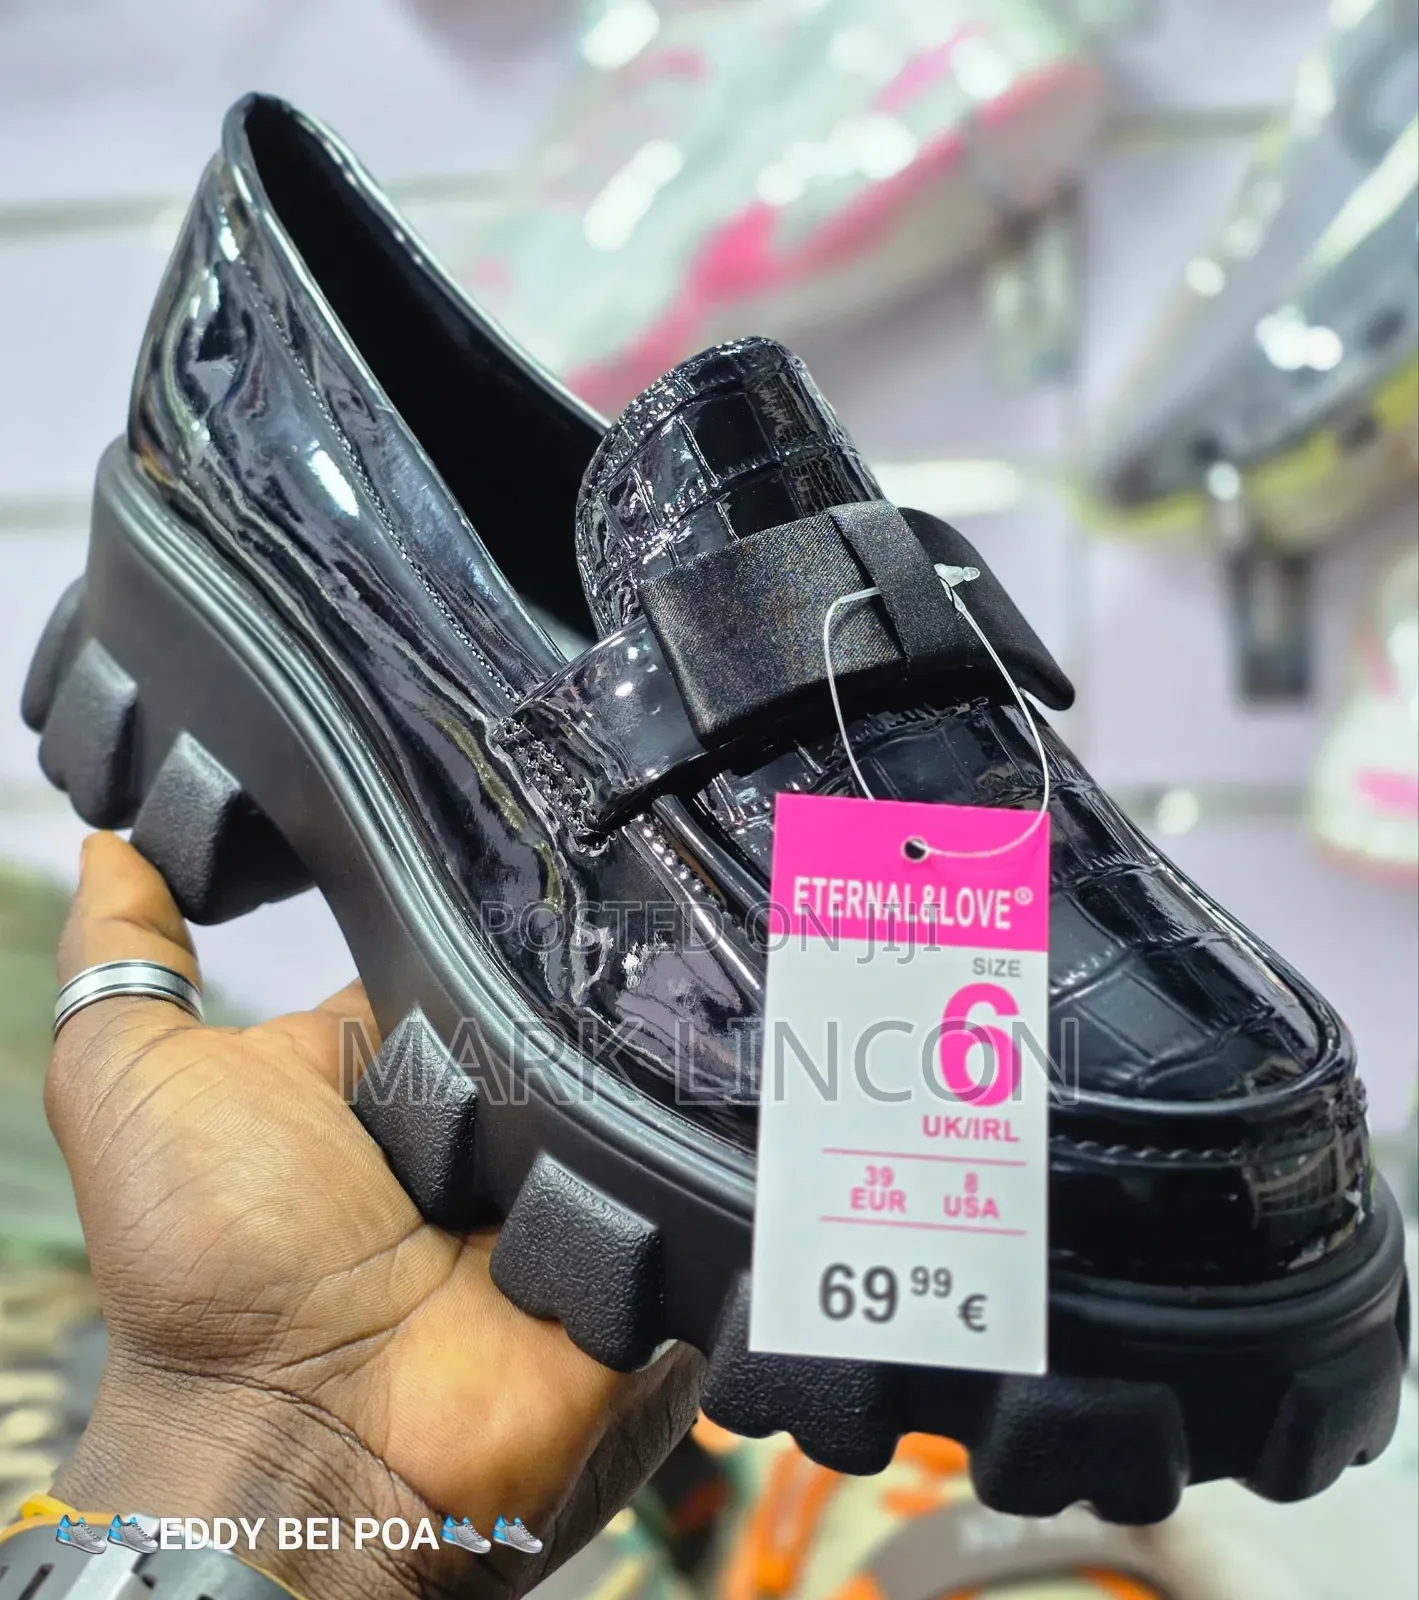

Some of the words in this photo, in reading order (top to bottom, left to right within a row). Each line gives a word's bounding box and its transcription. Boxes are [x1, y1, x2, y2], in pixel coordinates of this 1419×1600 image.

[972, 957, 1021, 977] SIZE
[939, 982, 1022, 1107] 6
[922, 1114, 1020, 1143] UK/IRL
[864, 1164, 895, 1187] 39
[963, 1172, 979, 1193] 8
[849, 1187, 907, 1213] EUR
[943, 1195, 1000, 1219] USA
[818, 1262, 900, 1323] 69
[909, 1265, 954, 1298] 99
[957, 1293, 988, 1333] €
